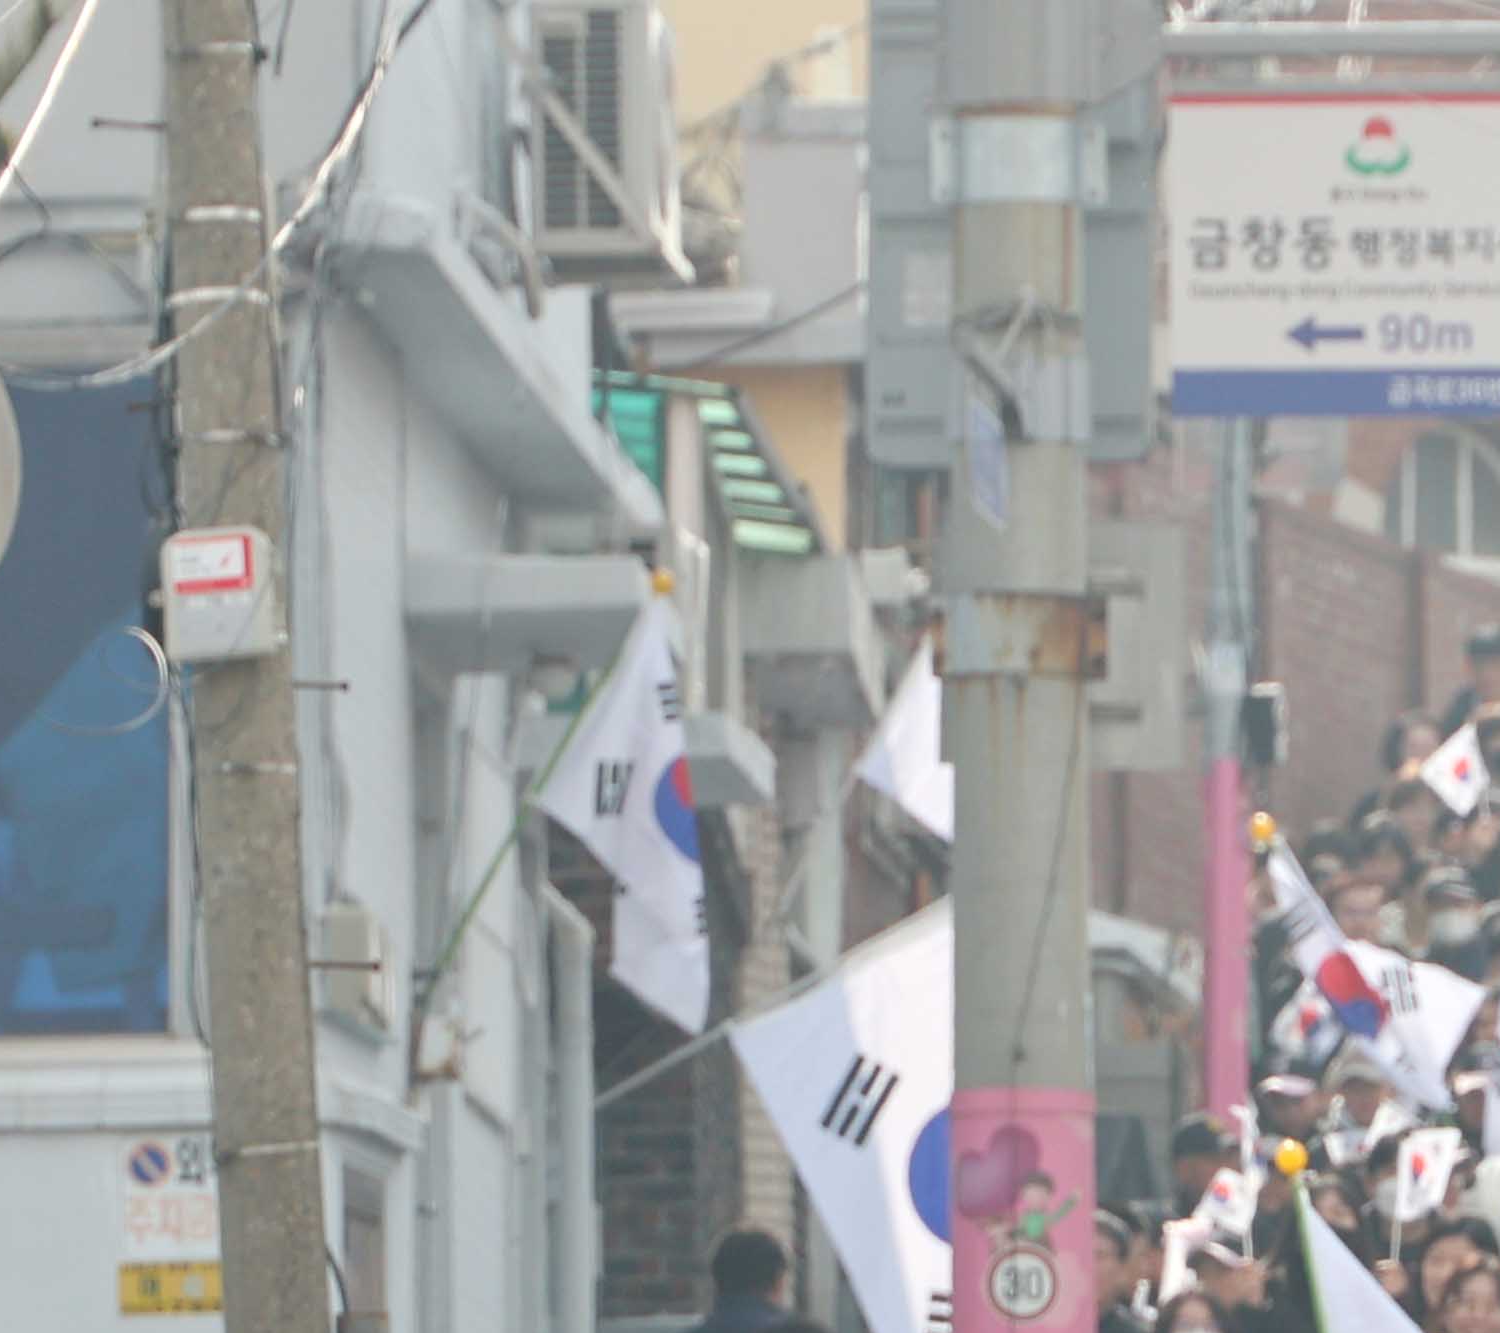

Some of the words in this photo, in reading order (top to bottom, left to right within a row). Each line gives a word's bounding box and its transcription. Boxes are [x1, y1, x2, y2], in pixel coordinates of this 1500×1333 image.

[1190, 217, 1338, 271] 금창동
[1379, 312, 1475, 354] 90m
[1003, 1265, 1043, 1302] 30
